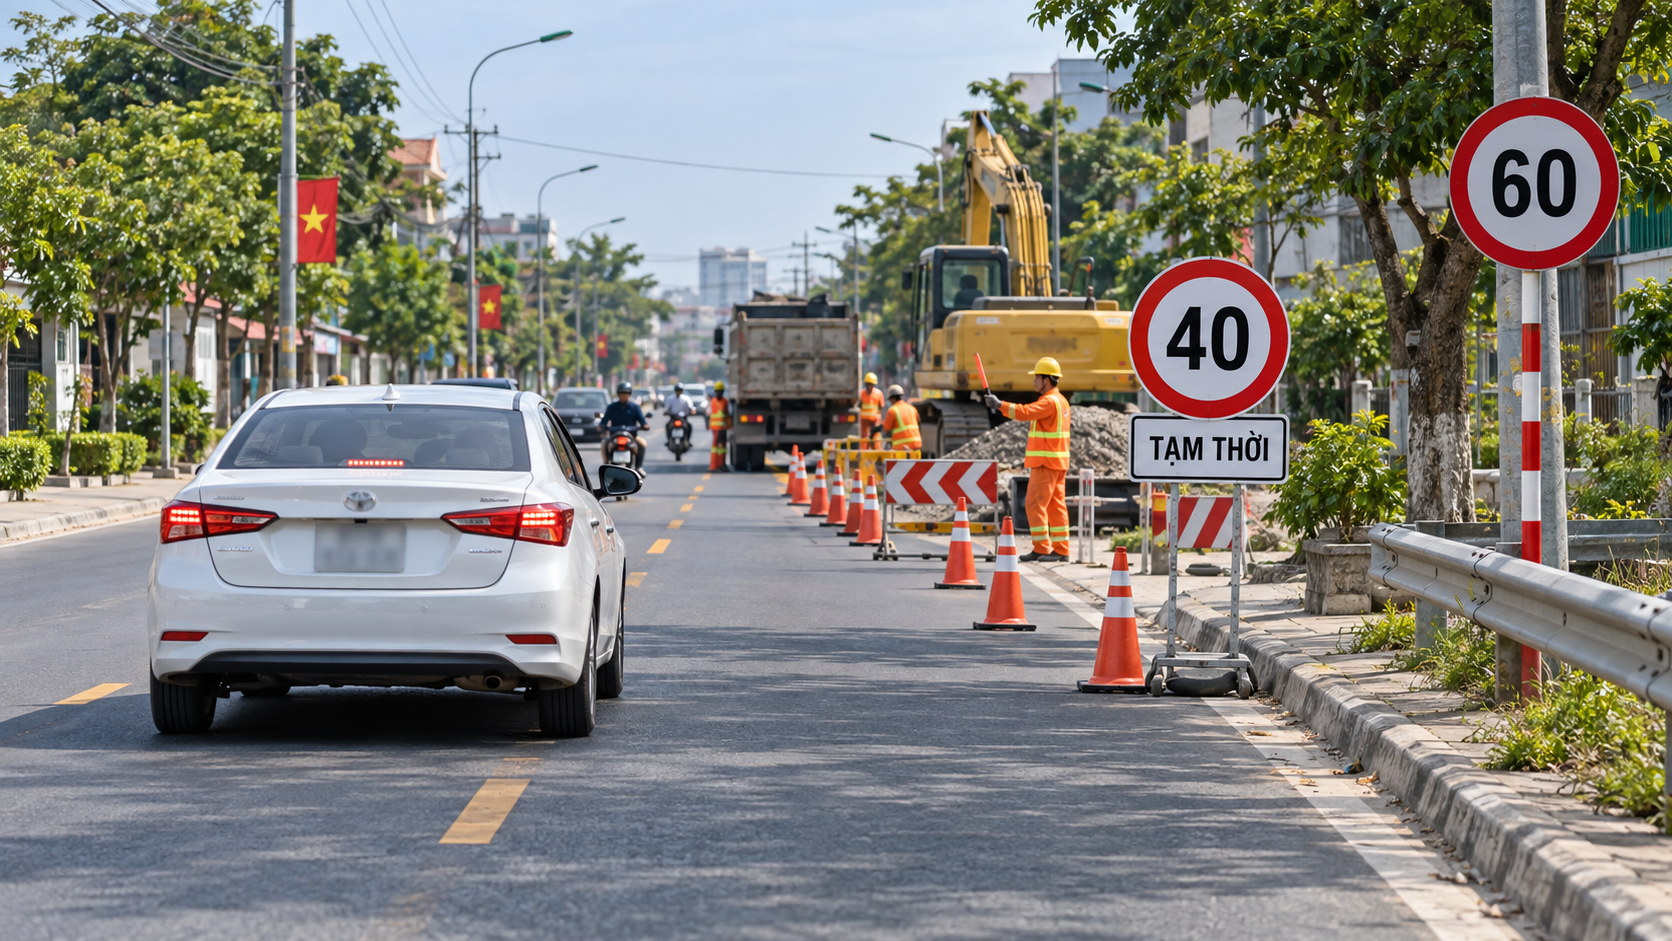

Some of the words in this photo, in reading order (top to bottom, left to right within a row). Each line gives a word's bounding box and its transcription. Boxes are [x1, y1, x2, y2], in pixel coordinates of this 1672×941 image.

[1491, 148, 1577, 219] 60
[1166, 305, 1250, 372] 40
[1149, 435, 1204, 467] TẠM
[1212, 430, 1269, 462] THỜI
